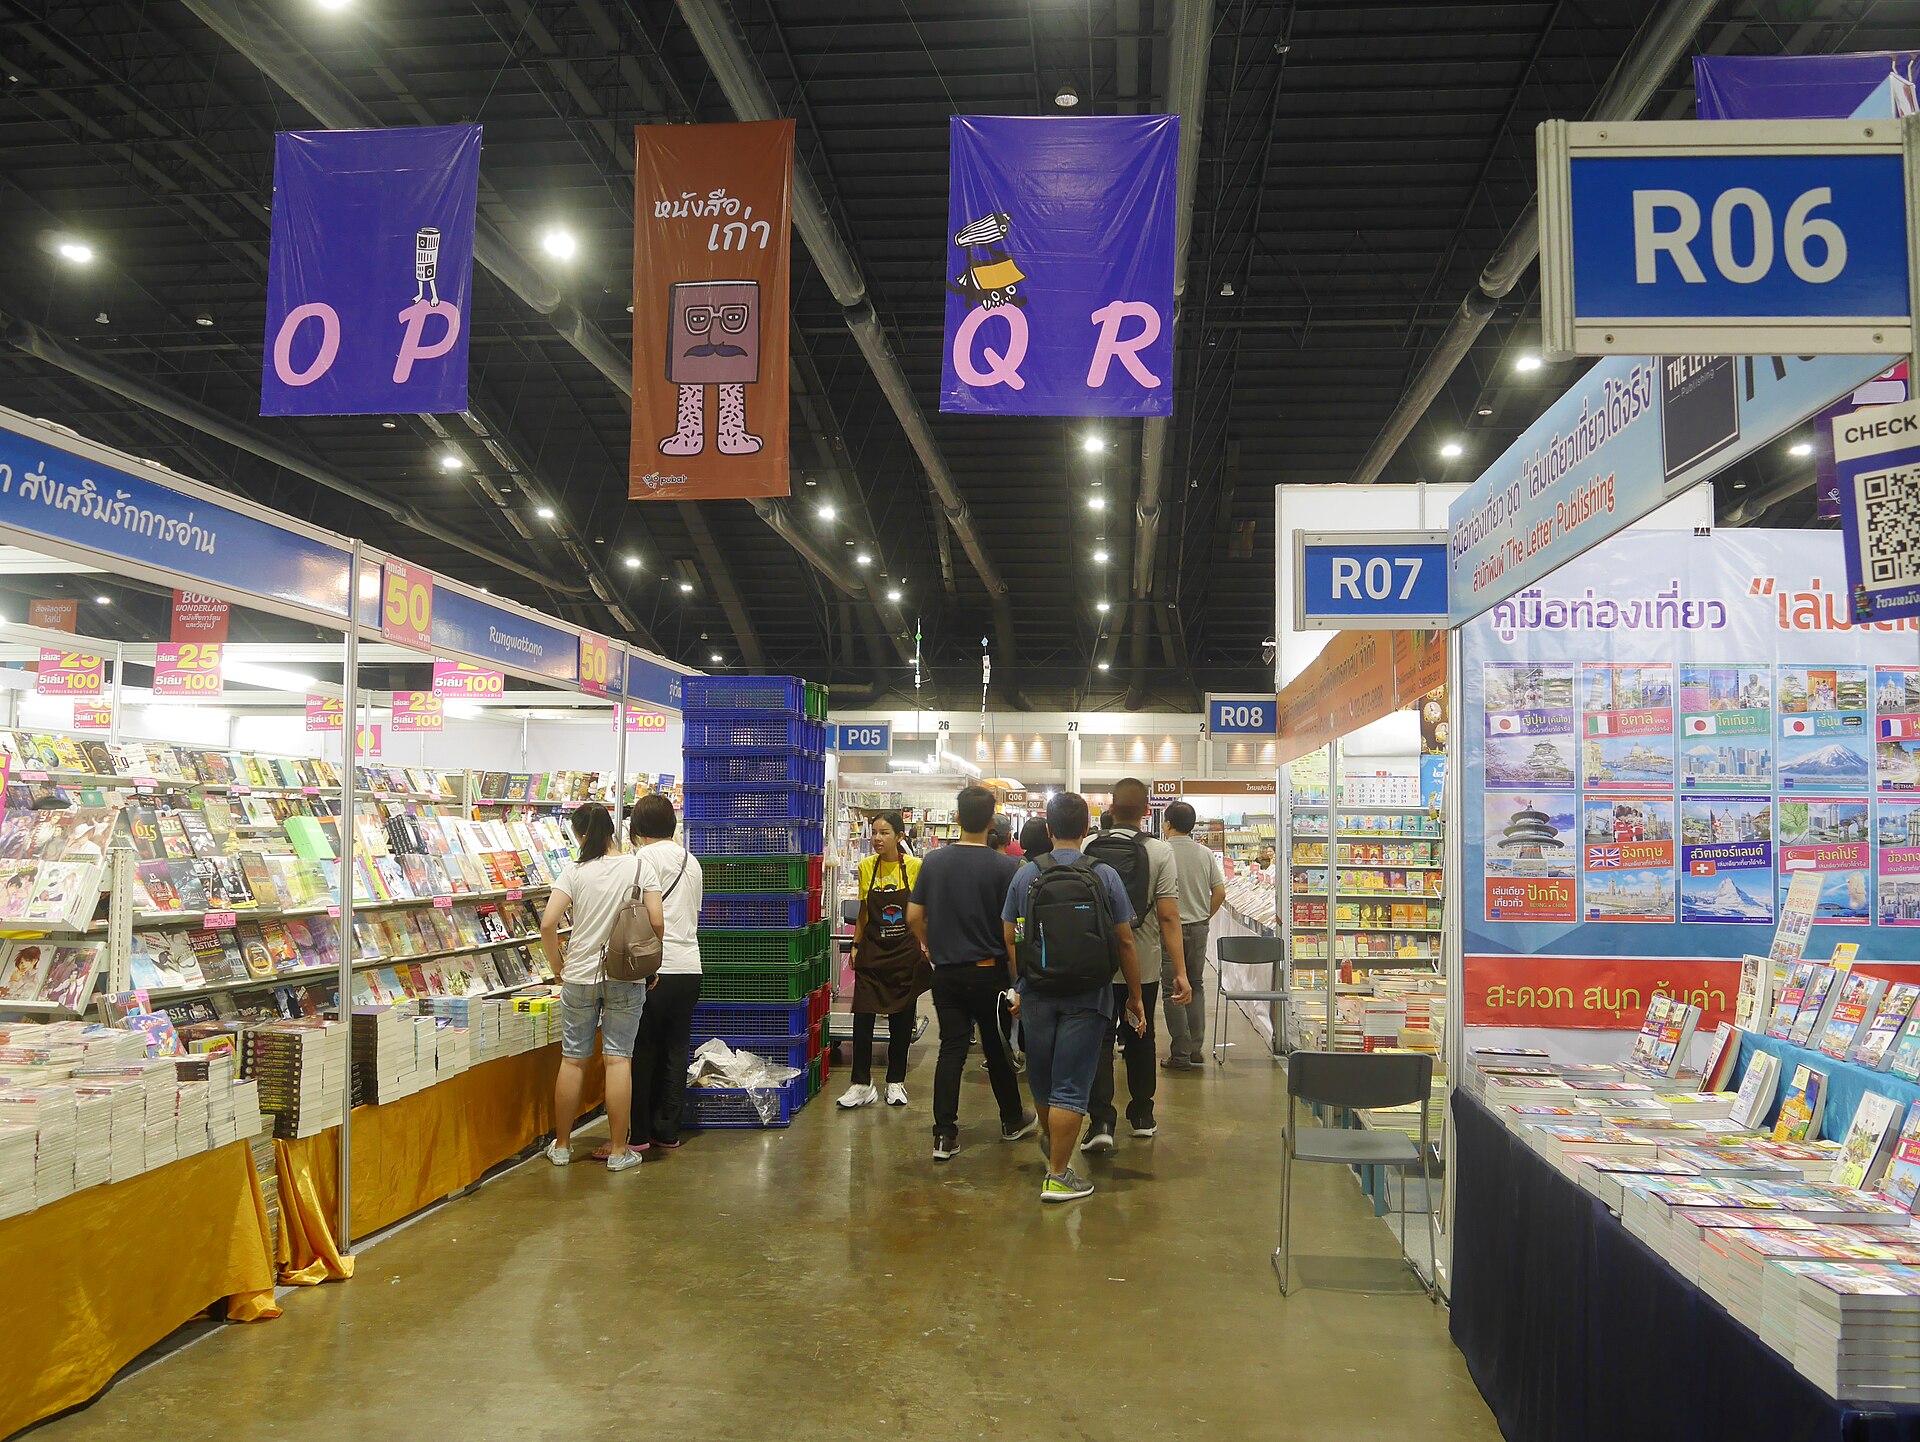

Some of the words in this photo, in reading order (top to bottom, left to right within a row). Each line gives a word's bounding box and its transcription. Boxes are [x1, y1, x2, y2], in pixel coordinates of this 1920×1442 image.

[653, 188, 740, 218] หนังสือ
[707, 207, 771, 251] เก่า
[1632, 187, 1847, 284] R06
[274, 302, 340, 386] O
[392, 300, 461, 384] P
[953, 302, 1029, 391] Q
[1087, 300, 1161, 388] R
[1667, 356, 1687, 391] THE
[1845, 415, 1918, 444] CHECK
[19, 461, 216, 555] ส่งเสริมรักการอ่าน
[1452, 484, 1504, 570] คู่มือท่องเที่ยว
[1507, 480, 1521, 528] ชุด
[1473, 544, 1504, 592] สำนักพิมพ์
[1507, 539, 1524, 570] The
[1526, 517, 1553, 557] Letter
[1556, 471, 1616, 536] Publishing
[1332, 557, 1423, 600] R07
[385, 574, 430, 632] 50
[1493, 580, 1727, 640] คู่มือท่องเที่ยว
[489, 626, 543, 656] Rungwattana
[40, 652, 60, 662] เล่มละ
[157, 653, 177, 662] เล่มละ
[177, 644, 220, 669] 25
[581, 642, 607, 684] 50
[65, 673, 99, 689] 100
[182, 673, 218, 690] 100
[463, 676, 502, 692] 100
[409, 692, 443, 711] 25
[414, 714, 442, 727] 100
[637, 715, 665, 728] 100
[938, 721, 950, 731] 26
[1220, 706, 1263, 727] R08
[1522, 711, 1546, 728] ญี่ปุ่น
[1621, 711, 1653, 726] อิตาลี
[1717, 714, 1755, 727] โตเกียว
[1816, 713, 1841, 729] ญี่ปุ่น
[1068, 722, 1079, 731] 27
[848, 729, 881, 746] P05
[1008, 793, 1023, 801] Q06
[1157, 783, 1175, 792] R09
[135, 819, 157, 841] 615
[1622, 845, 1664, 860] อังกฤษ
[1690, 843, 1763, 860] สวิตเซอร์แลนด์
[1817, 845, 1859, 861] สิงคโปร์
[1492, 886, 1525, 896] เล่มเดียว
[1527, 880, 1569, 902] ปักกิ่ง
[1494, 896, 1524, 908] เที่ยวทั่ว
[218, 914, 228, 925] 50
[1486, 984, 1574, 1009] สะดวก
[1583, 985, 1641, 1019] สนุก
